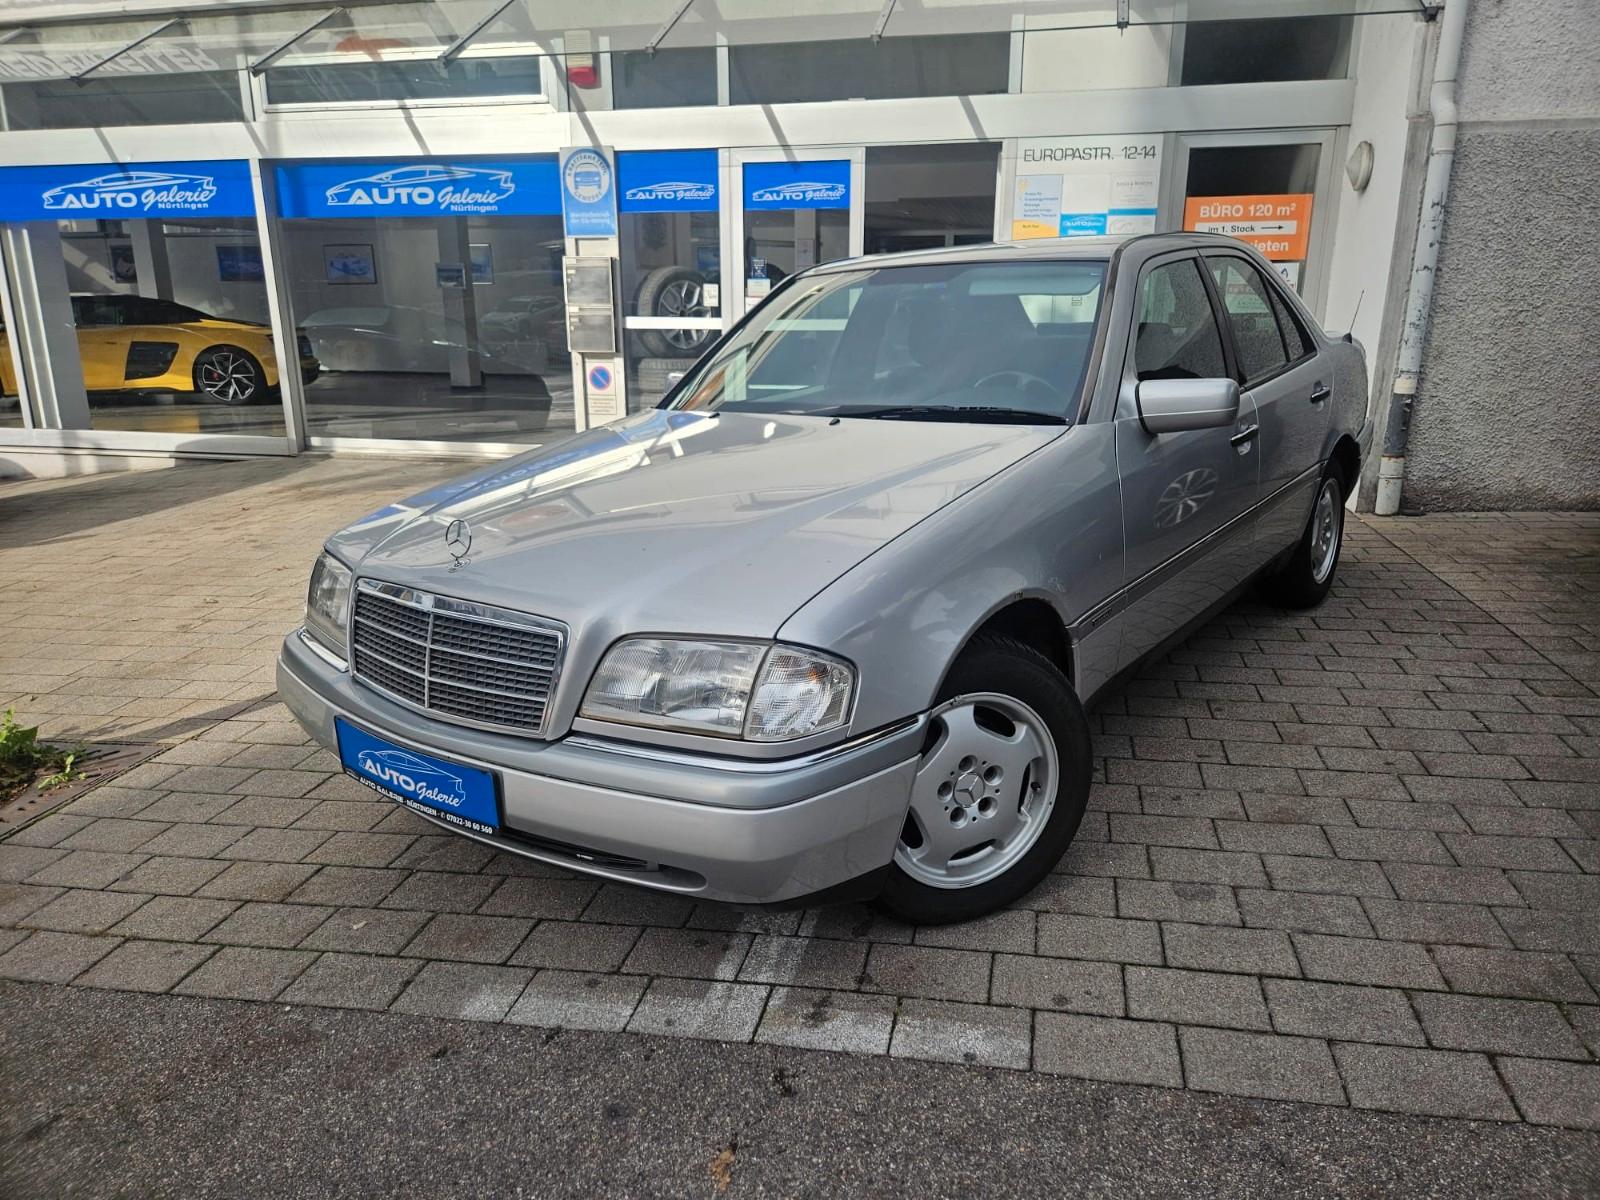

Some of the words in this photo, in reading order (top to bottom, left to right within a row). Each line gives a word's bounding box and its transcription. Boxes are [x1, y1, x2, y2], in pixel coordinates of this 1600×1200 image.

[1023, 147, 1115, 162] EUROPASTR.
[1121, 145, 1157, 160] 12-14
[61, 192, 137, 209] AUTO
[349, 186, 435, 205] AUTO
[637, 191, 675, 200] AUTO
[762, 192, 803, 201] AUTO
[158, 202, 209, 211] Nürtingen
[450, 204, 498, 213] Nürtingen
[1200, 203, 1243, 218] BÜRO
[1248, 203, 1273, 217] 120
[1231, 224, 1255, 233] Stock
[364, 758, 415, 792] AUTO
[360, 777, 376, 789] AUTO
